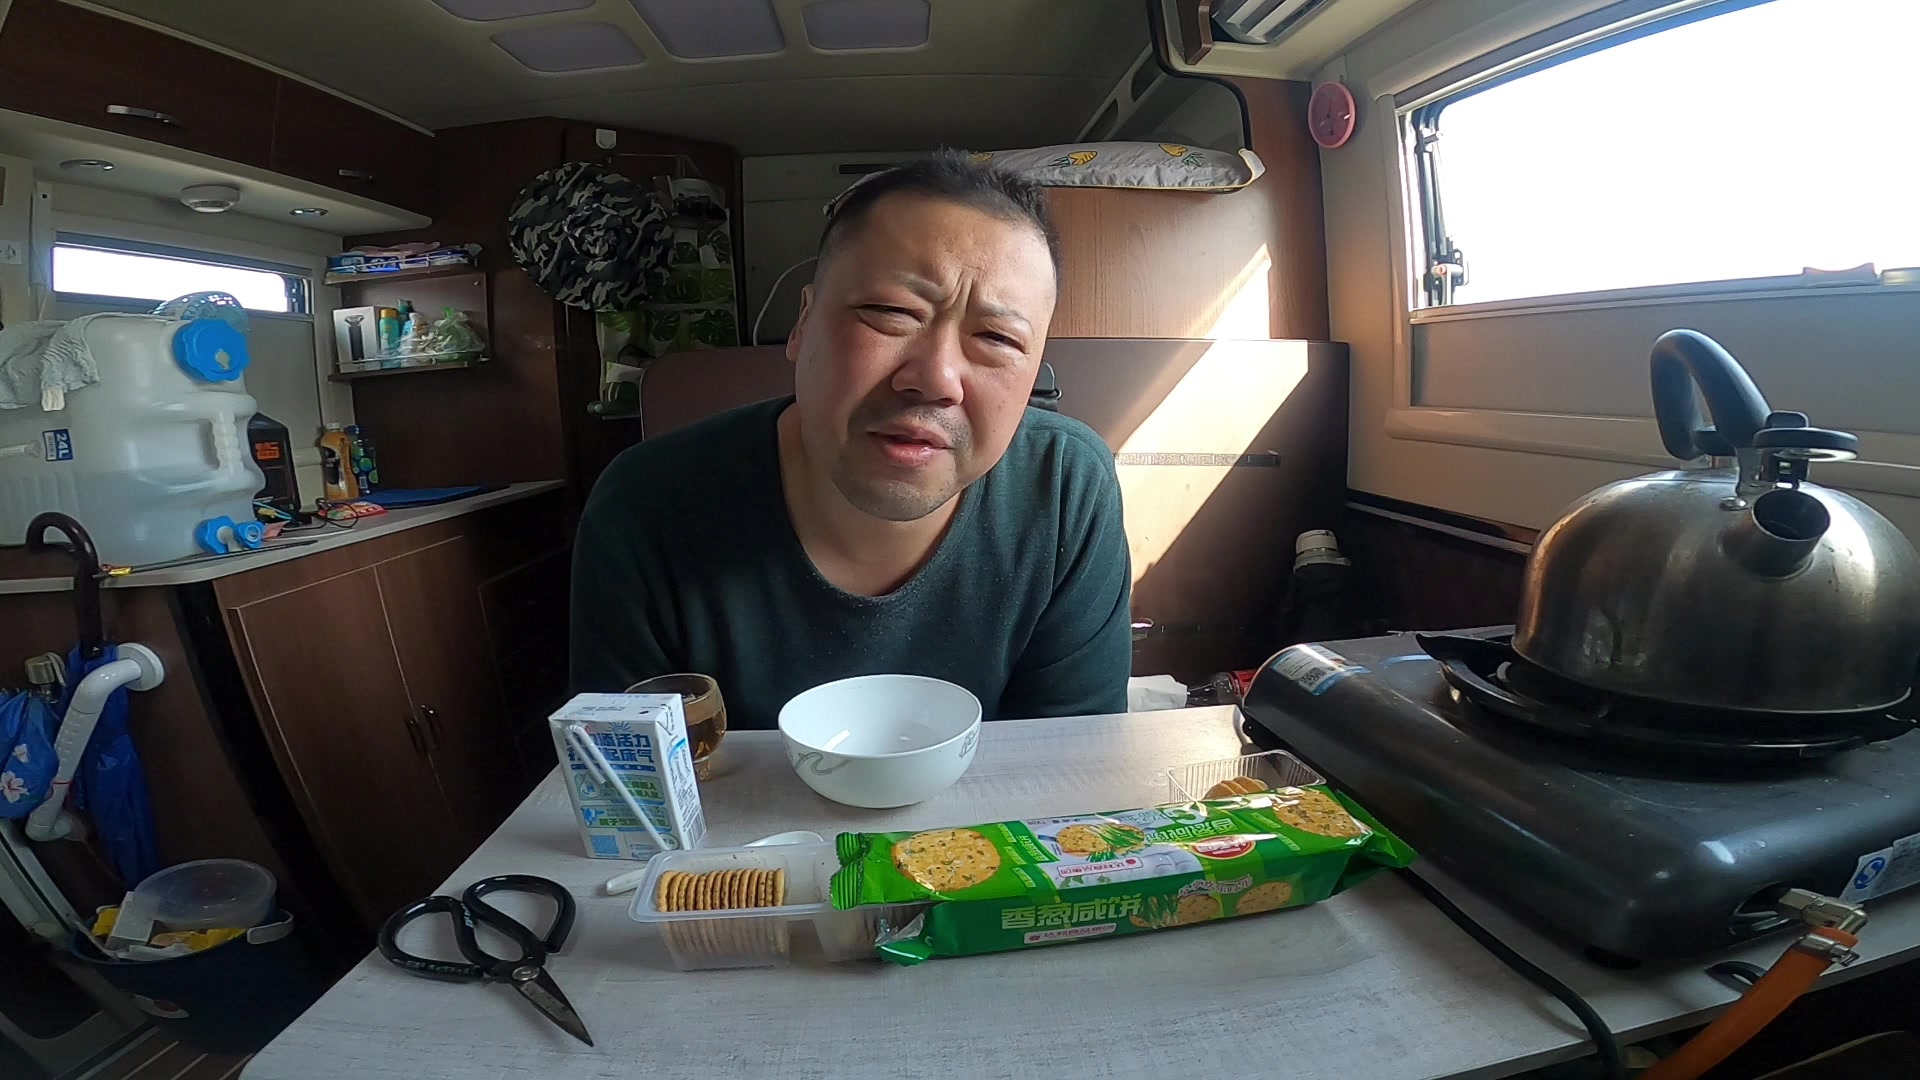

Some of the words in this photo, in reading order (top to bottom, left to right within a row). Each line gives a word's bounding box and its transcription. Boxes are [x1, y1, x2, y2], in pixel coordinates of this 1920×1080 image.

[57, 434, 69, 458] 24L
[1002, 893, 1143, 930] 香葱咸饼
